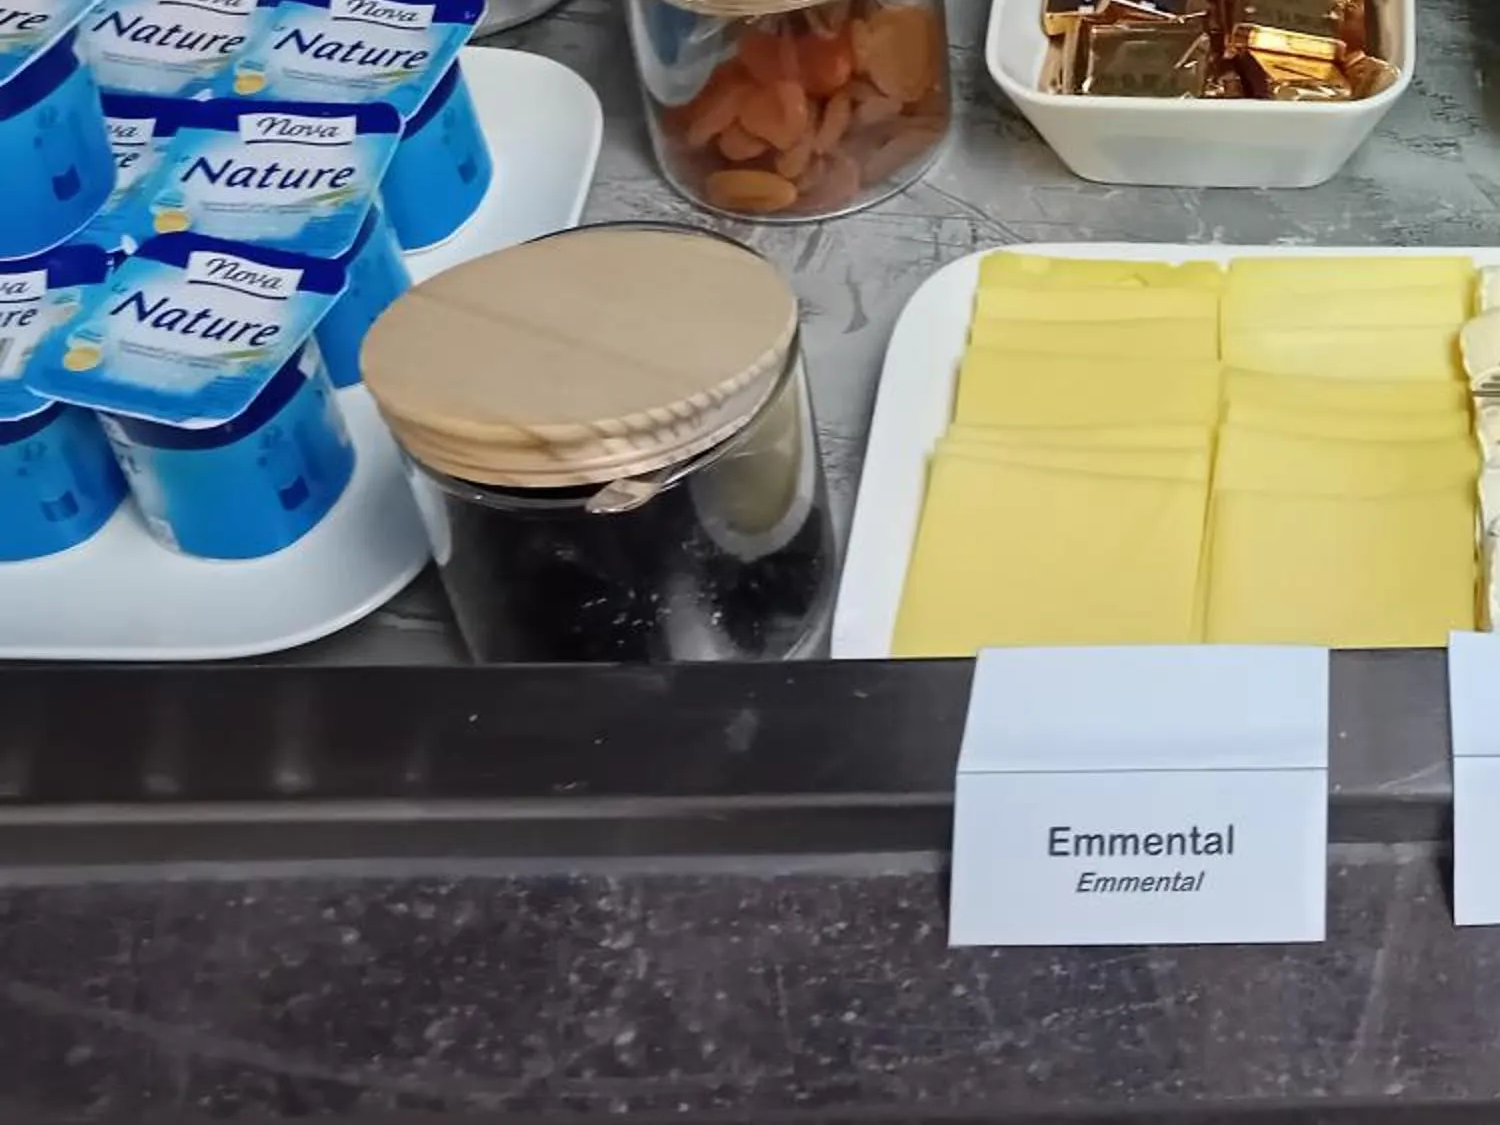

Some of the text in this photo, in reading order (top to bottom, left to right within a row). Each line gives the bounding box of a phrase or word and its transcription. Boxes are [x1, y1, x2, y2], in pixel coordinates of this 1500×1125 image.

[92, 10, 247, 55] Nature
[273, 28, 430, 70] Nature
[256, 115, 341, 138] Nova
[181, 156, 355, 190] Nature
[206, 257, 283, 290] Nova
[109, 290, 281, 346] Nature
[1048, 824, 1234, 857] Emmental
[1075, 870, 1206, 894] Emmental
